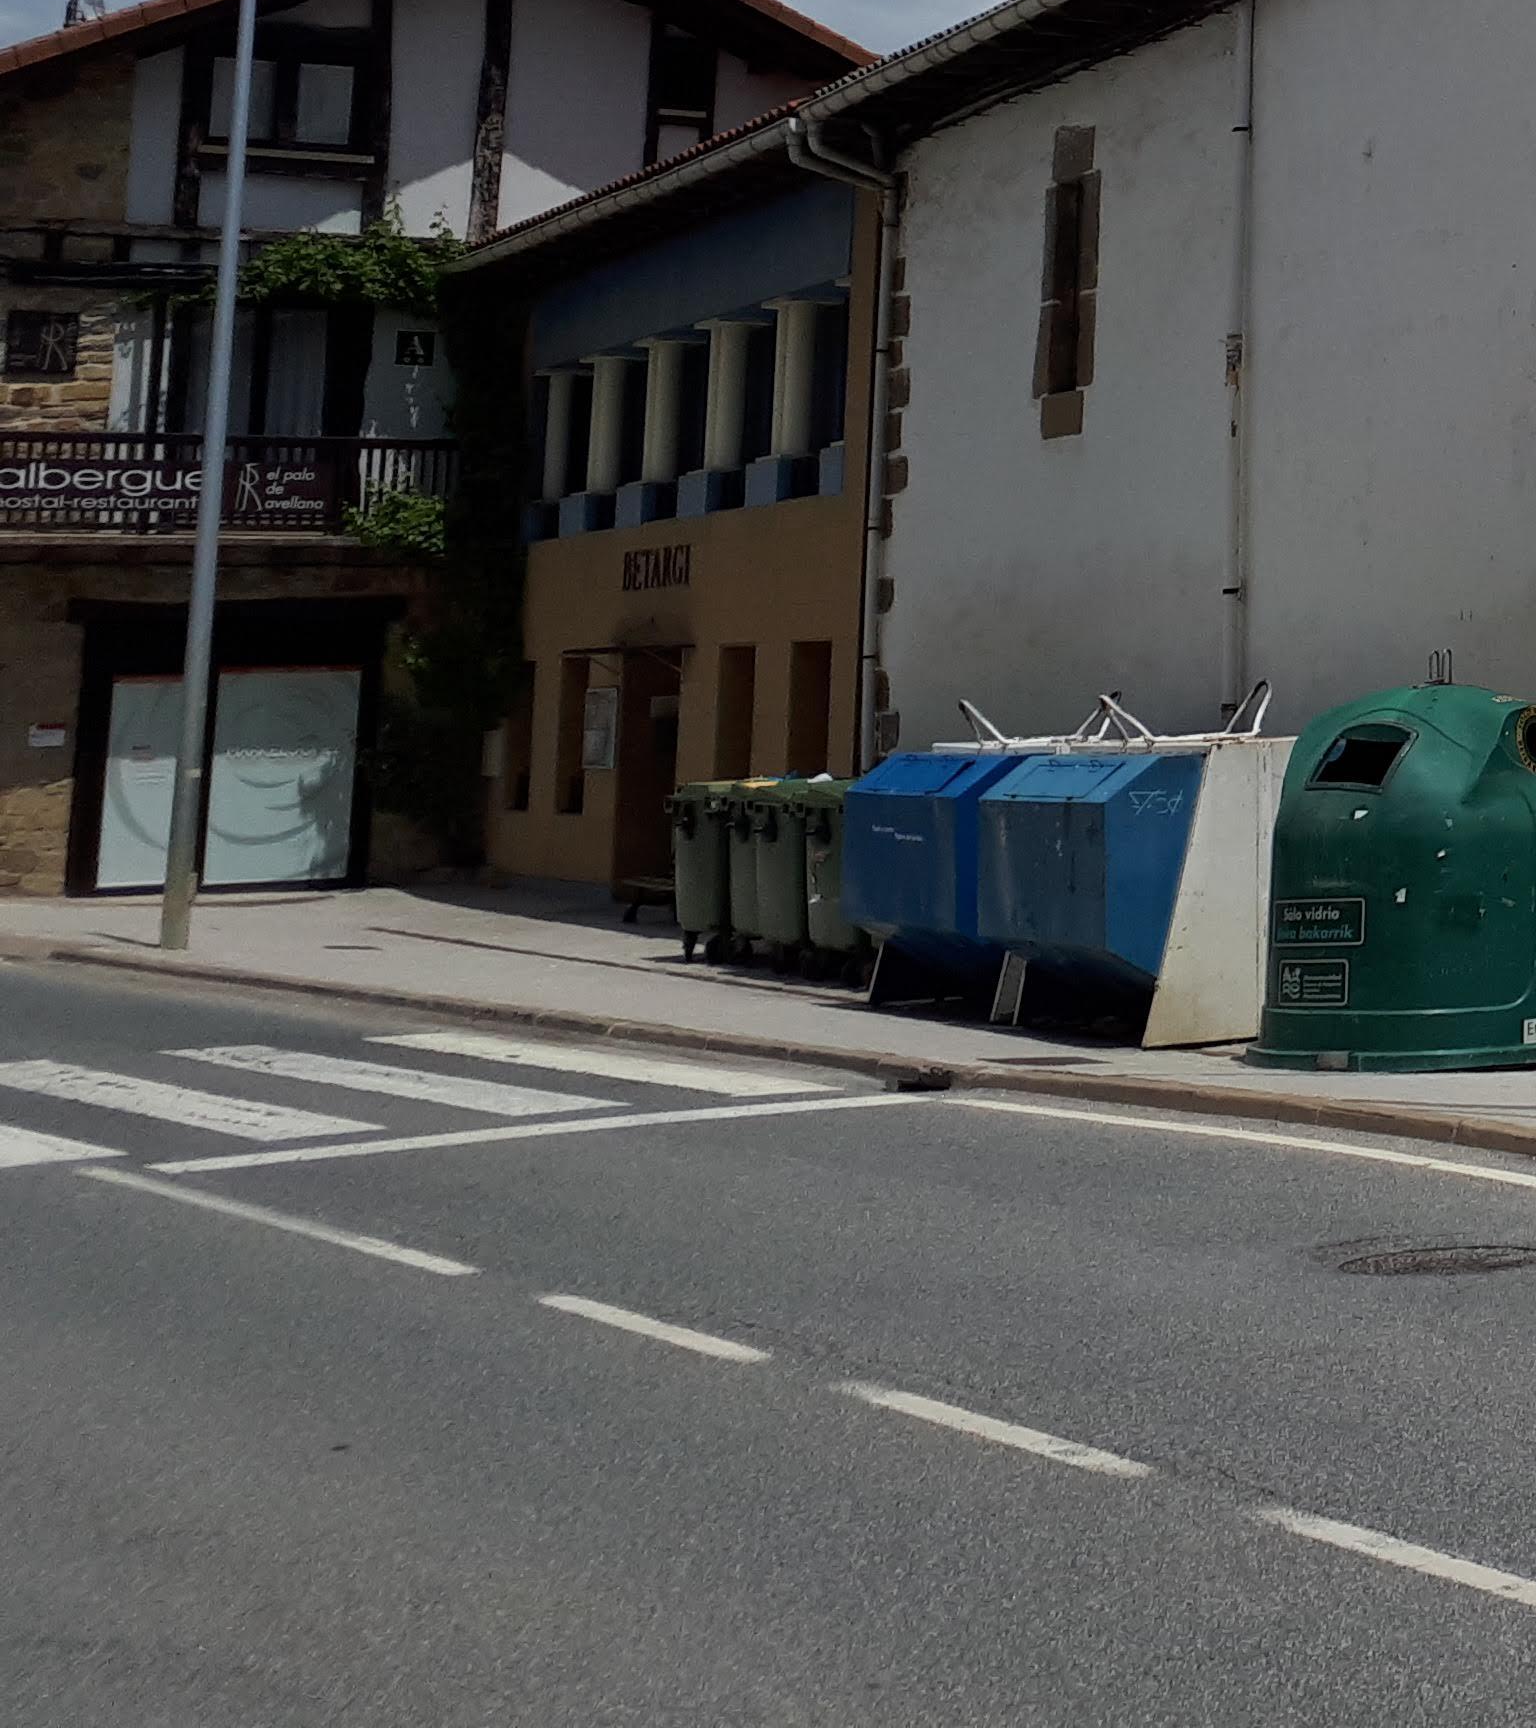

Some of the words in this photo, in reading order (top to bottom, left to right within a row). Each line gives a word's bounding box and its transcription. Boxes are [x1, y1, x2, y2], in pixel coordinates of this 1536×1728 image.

[267, 467, 280, 481] el
[283, 467, 316, 484] palo
[266, 482, 284, 495] de
[0, 494, 200, 510] ostal-restaurant
[265, 497, 324, 510] avellano
[1305, 905, 1341, 921] vidrio
